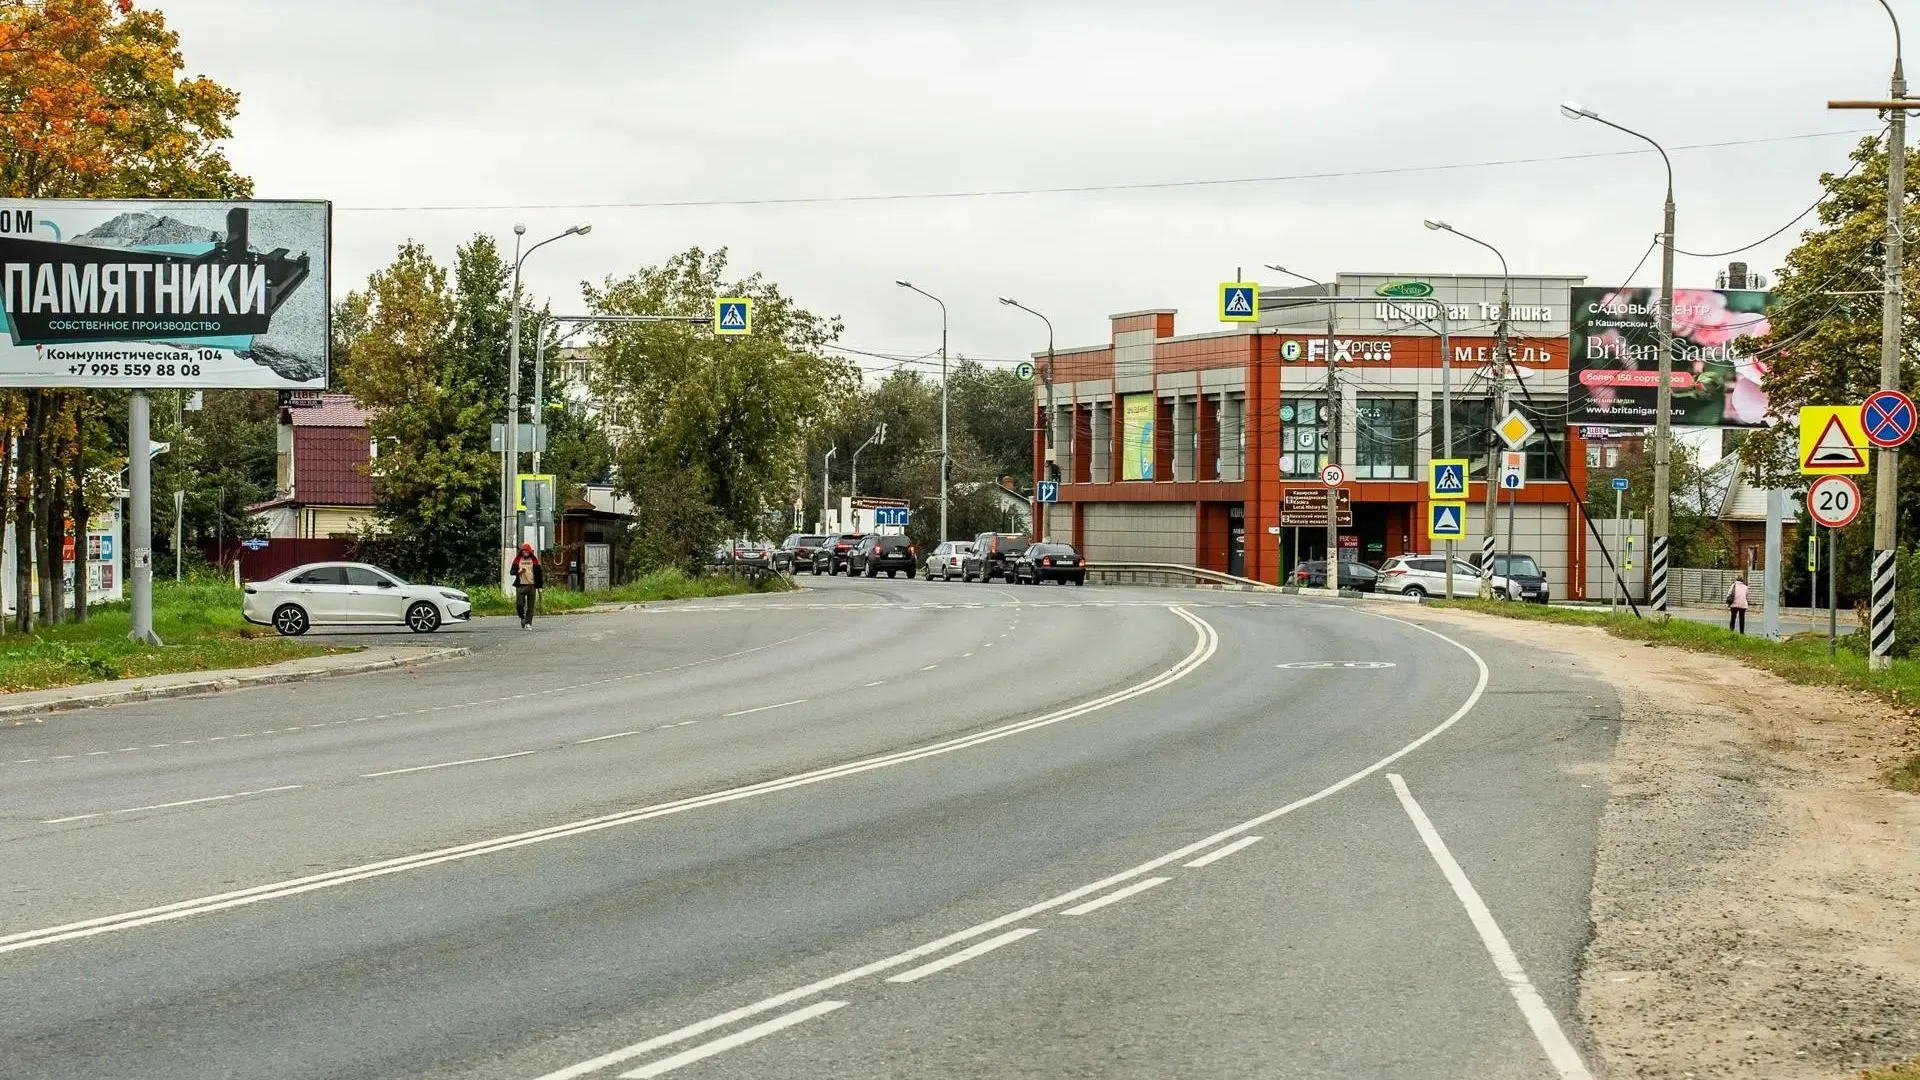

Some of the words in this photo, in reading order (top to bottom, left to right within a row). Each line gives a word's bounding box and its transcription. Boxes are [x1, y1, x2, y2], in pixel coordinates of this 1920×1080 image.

[5, 263, 266, 315] ПАМЯТНИКИ
[1375, 302, 1469, 323] Цифроая
[1479, 302, 1552, 322] Теника
[1588, 303, 1660, 316] САДОВЫЙ
[1666, 304, 1710, 316] ЕНТР
[49, 321, 129, 331] СОБСТВЕННОЕ
[132, 321, 221, 332] ПРОИЗВОДСТВО
[1595, 320, 1648, 330] Каширском
[47, 348, 193, 362] Коммунистическая,
[197, 350, 222, 361] 104
[1287, 344, 1296, 356] F
[1307, 340, 1354, 362] FIX
[1352, 341, 1392, 355] price
[68, 364, 87, 376] +7
[91, 364, 119, 376] 995
[124, 364, 151, 376] 559
[156, 364, 175, 376] 88
[180, 364, 201, 376] 08
[1587, 373, 1614, 381] более
[1634, 375, 1661, 383] сорто
[1327, 471, 1339, 481] 50
[1819, 491, 1849, 511] 20
